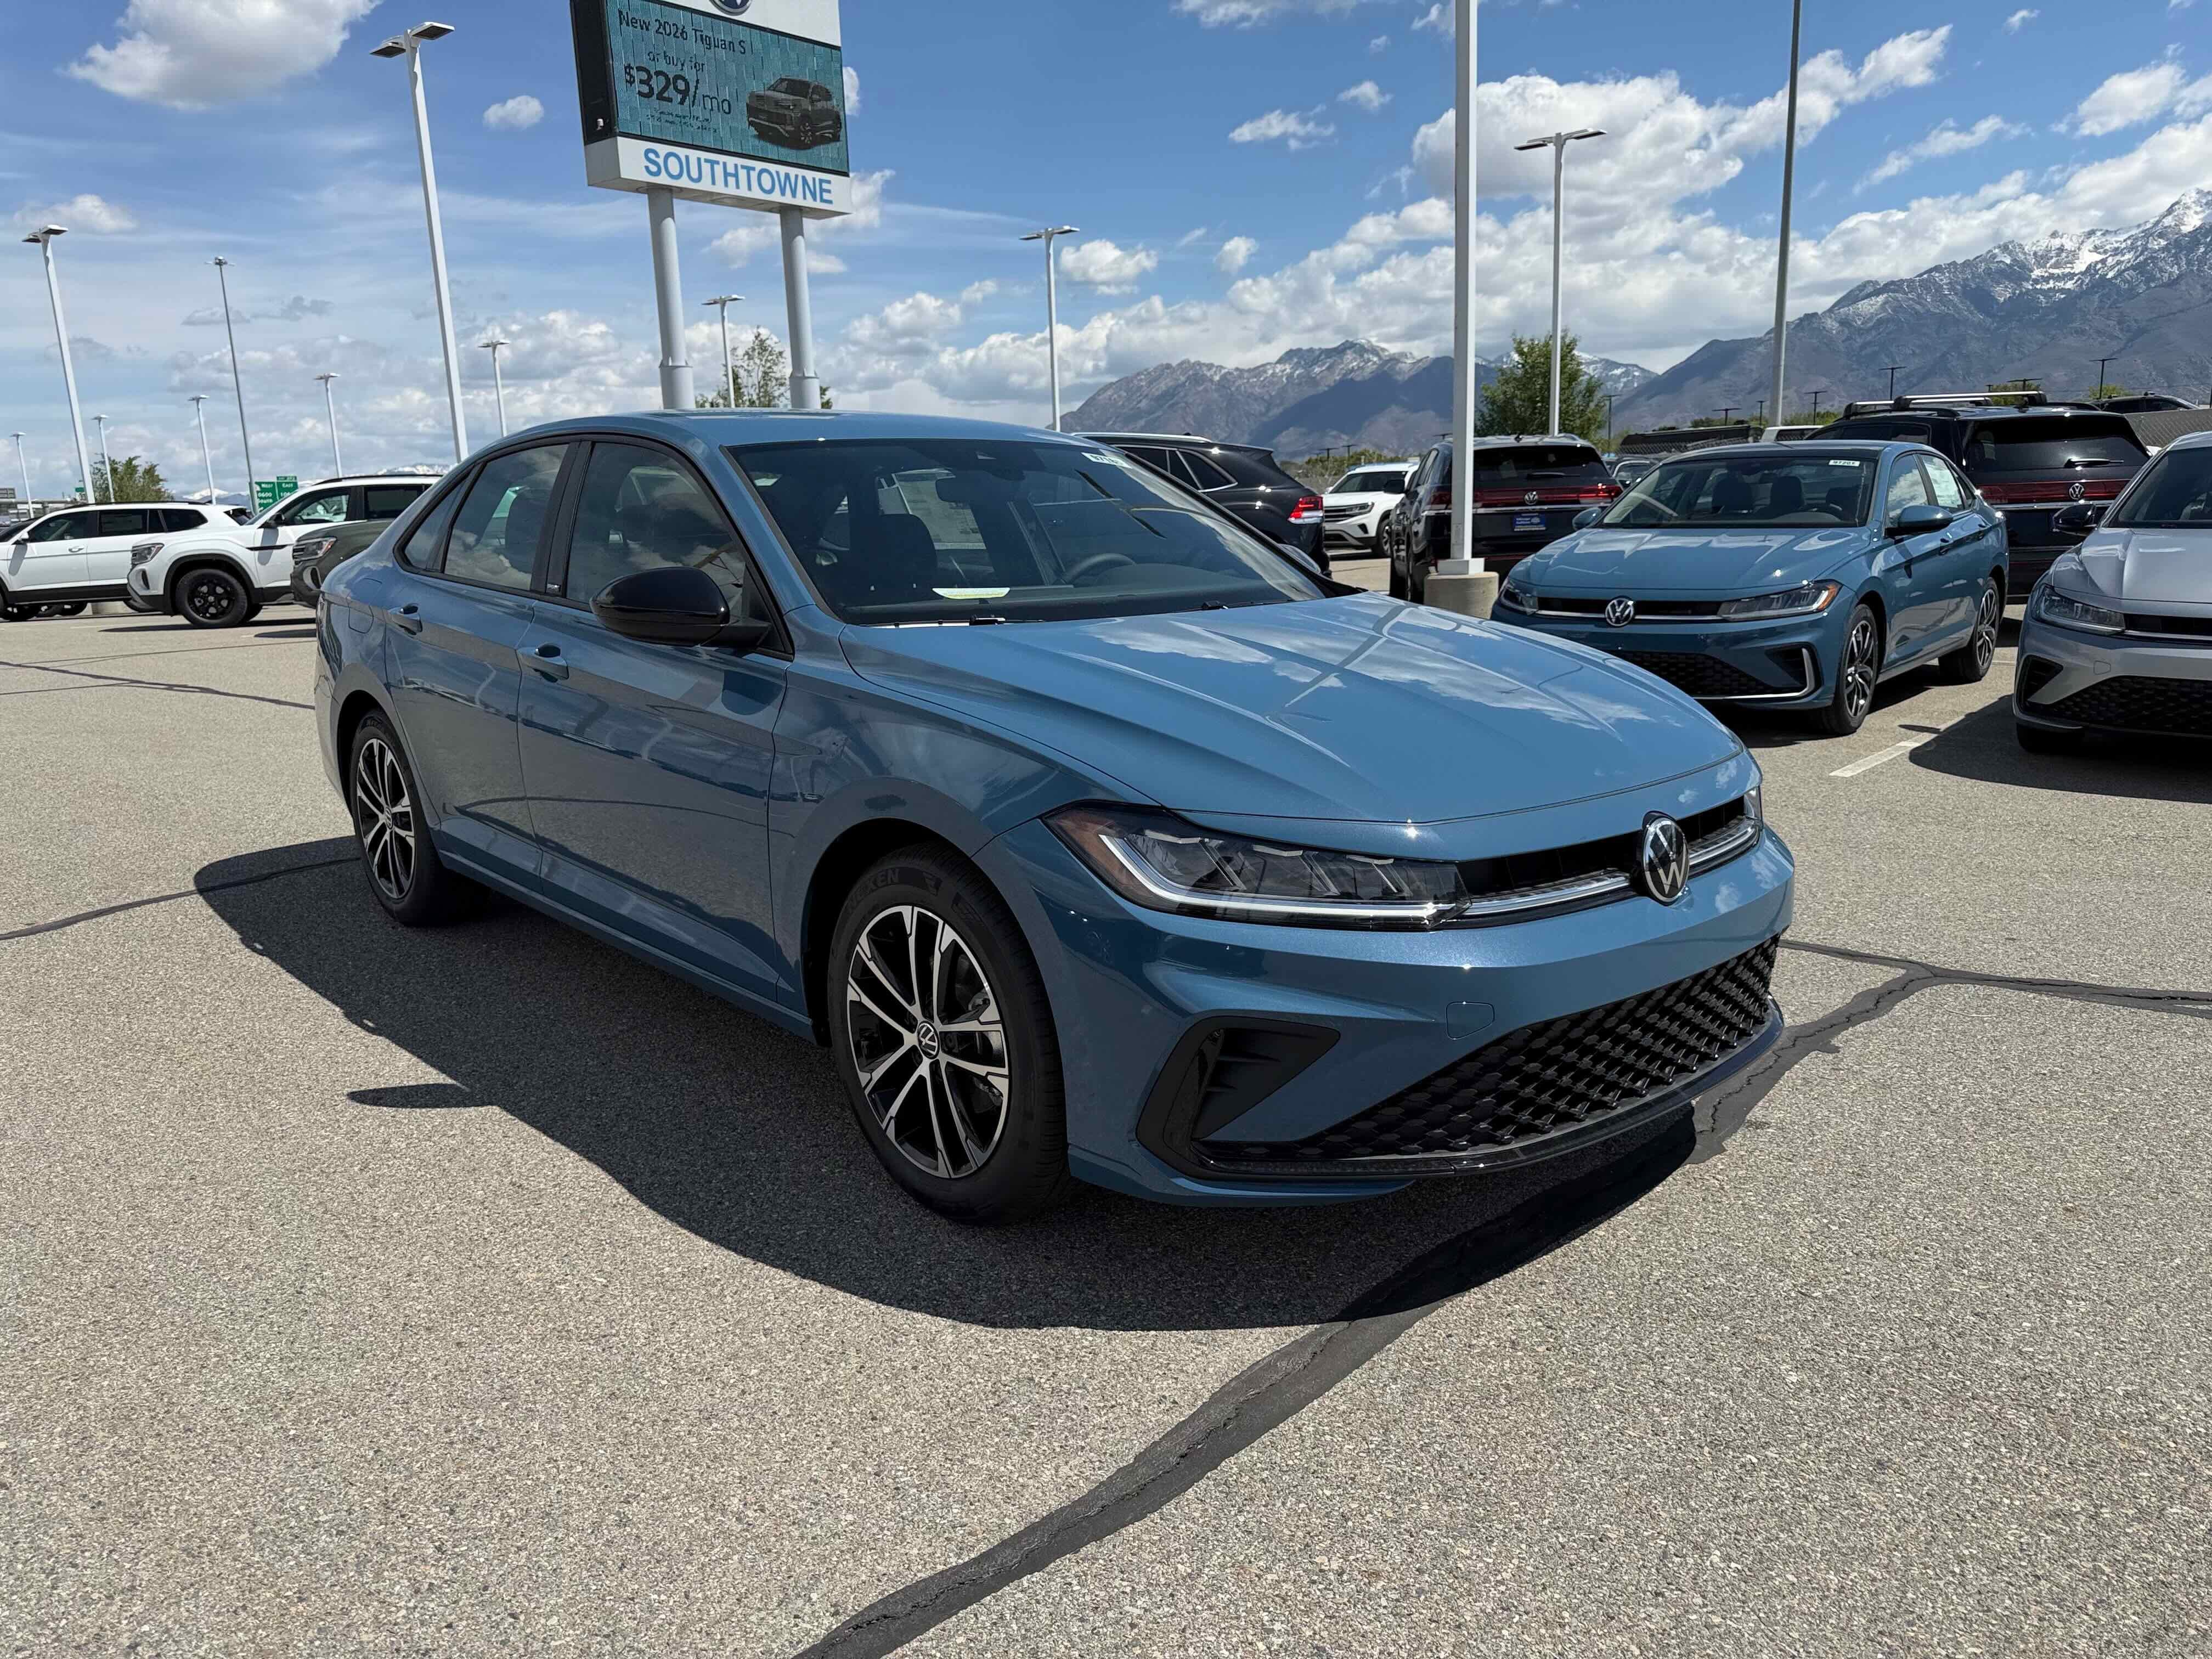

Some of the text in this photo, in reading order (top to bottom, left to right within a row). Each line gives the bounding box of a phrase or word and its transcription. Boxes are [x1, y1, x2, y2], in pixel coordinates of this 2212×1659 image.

[618, 9, 746, 54] New 2026 Tiguan S
[663, 50, 685, 71] buy
[644, 148, 834, 205] SOUTHTOWNE
